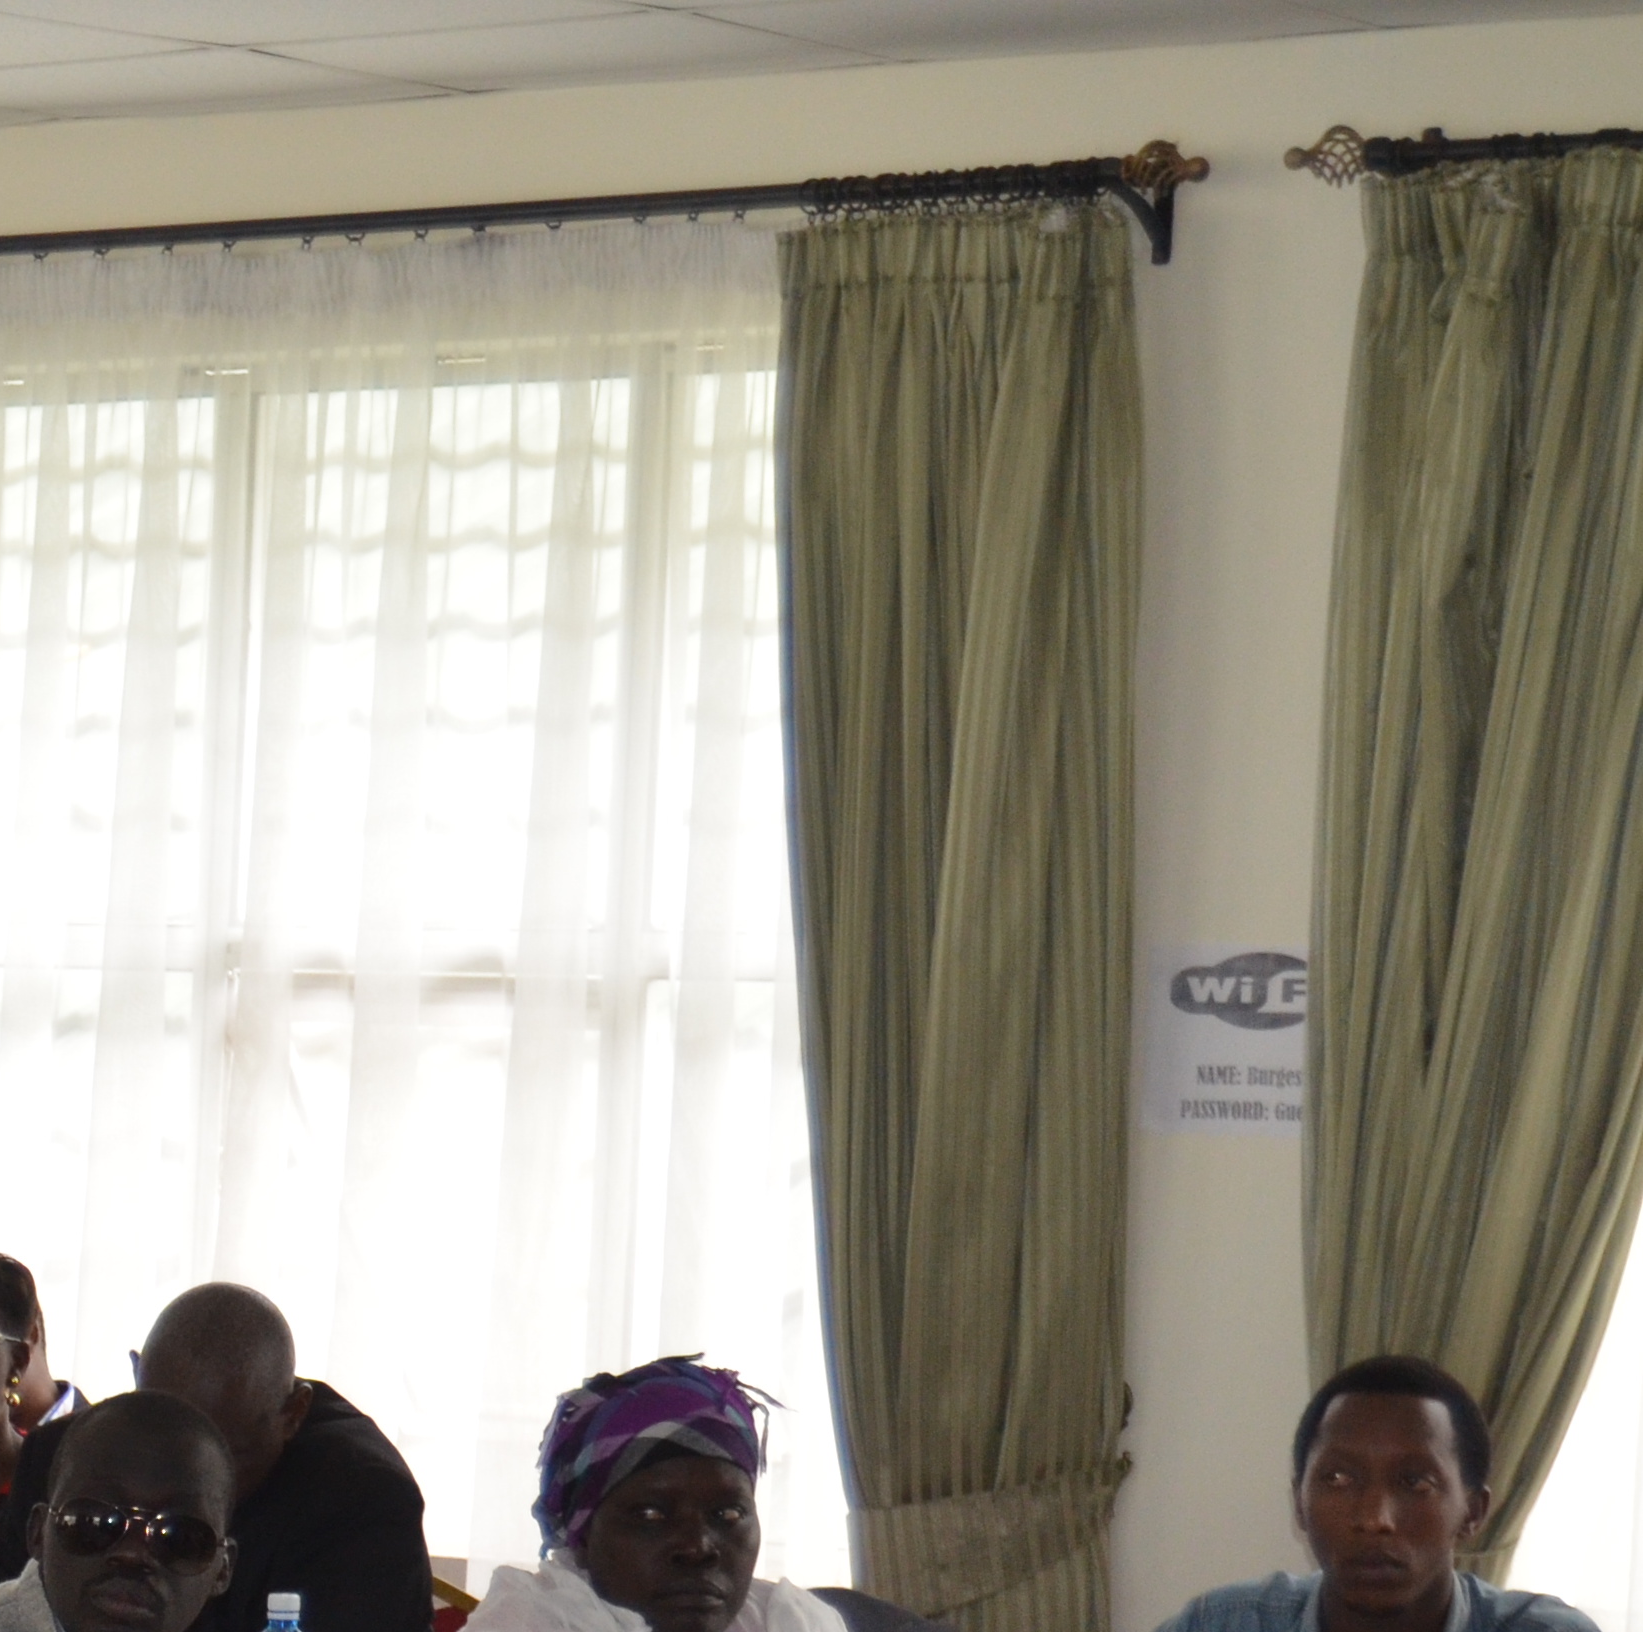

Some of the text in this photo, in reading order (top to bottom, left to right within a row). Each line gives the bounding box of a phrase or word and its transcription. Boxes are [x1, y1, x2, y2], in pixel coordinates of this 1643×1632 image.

[1186, 972, 1307, 1004] WiF
[1196, 1064, 1303, 1089] NAME: Burges
[1180, 1100, 1269, 1122] PASSWORD:
